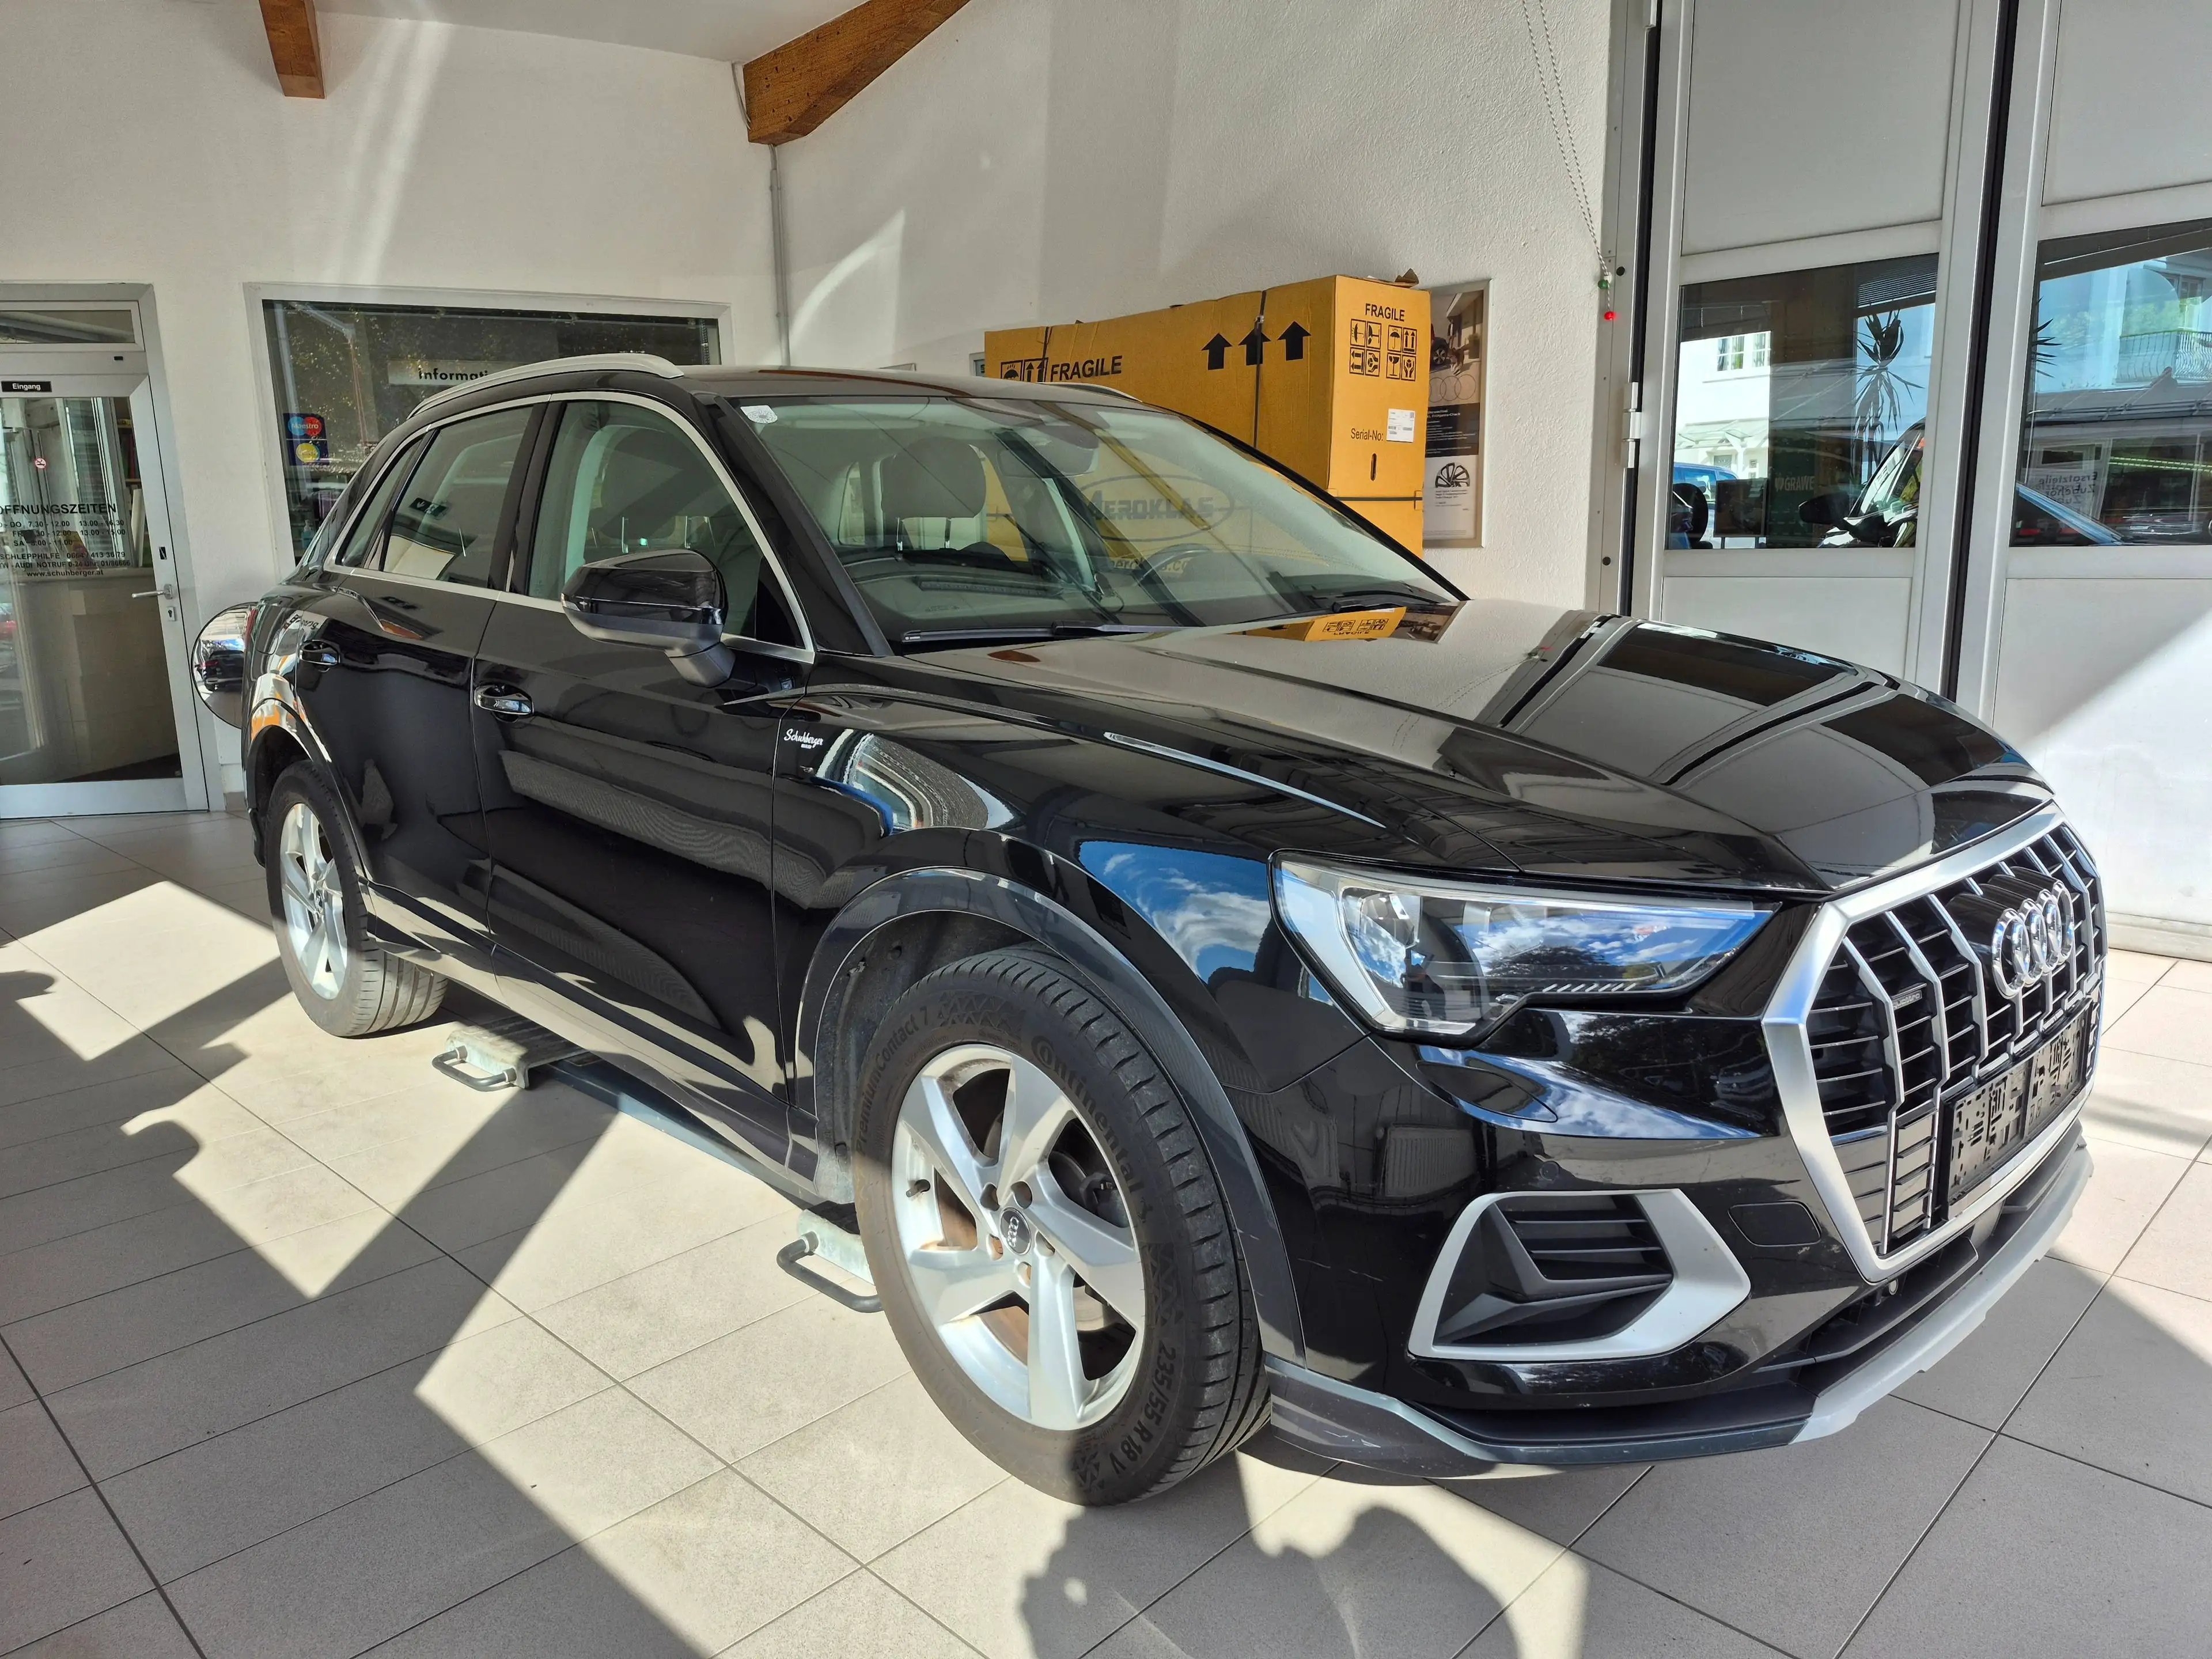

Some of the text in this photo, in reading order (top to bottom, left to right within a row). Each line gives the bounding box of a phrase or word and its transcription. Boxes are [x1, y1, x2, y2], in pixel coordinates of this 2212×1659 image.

[1365, 303, 1405, 322] FRAGILE
[1050, 355, 1123, 382] FRAGILE
[1350, 428, 1384, 441] Serial-No:
[1786, 475, 1815, 491] GRAWE
[36, 560, 66, 569] NOTRUF
[783, 728, 824, 748] Schuhberger
[855, 1013, 919, 1154] PremiumContact
[919, 1006, 929, 1027] 7
[1031, 1036, 1144, 1193] Continental
[1146, 1339, 1177, 1426] 235/55
[1133, 1419, 1154, 1441] R
[1120, 1434, 1143, 1462] 18
